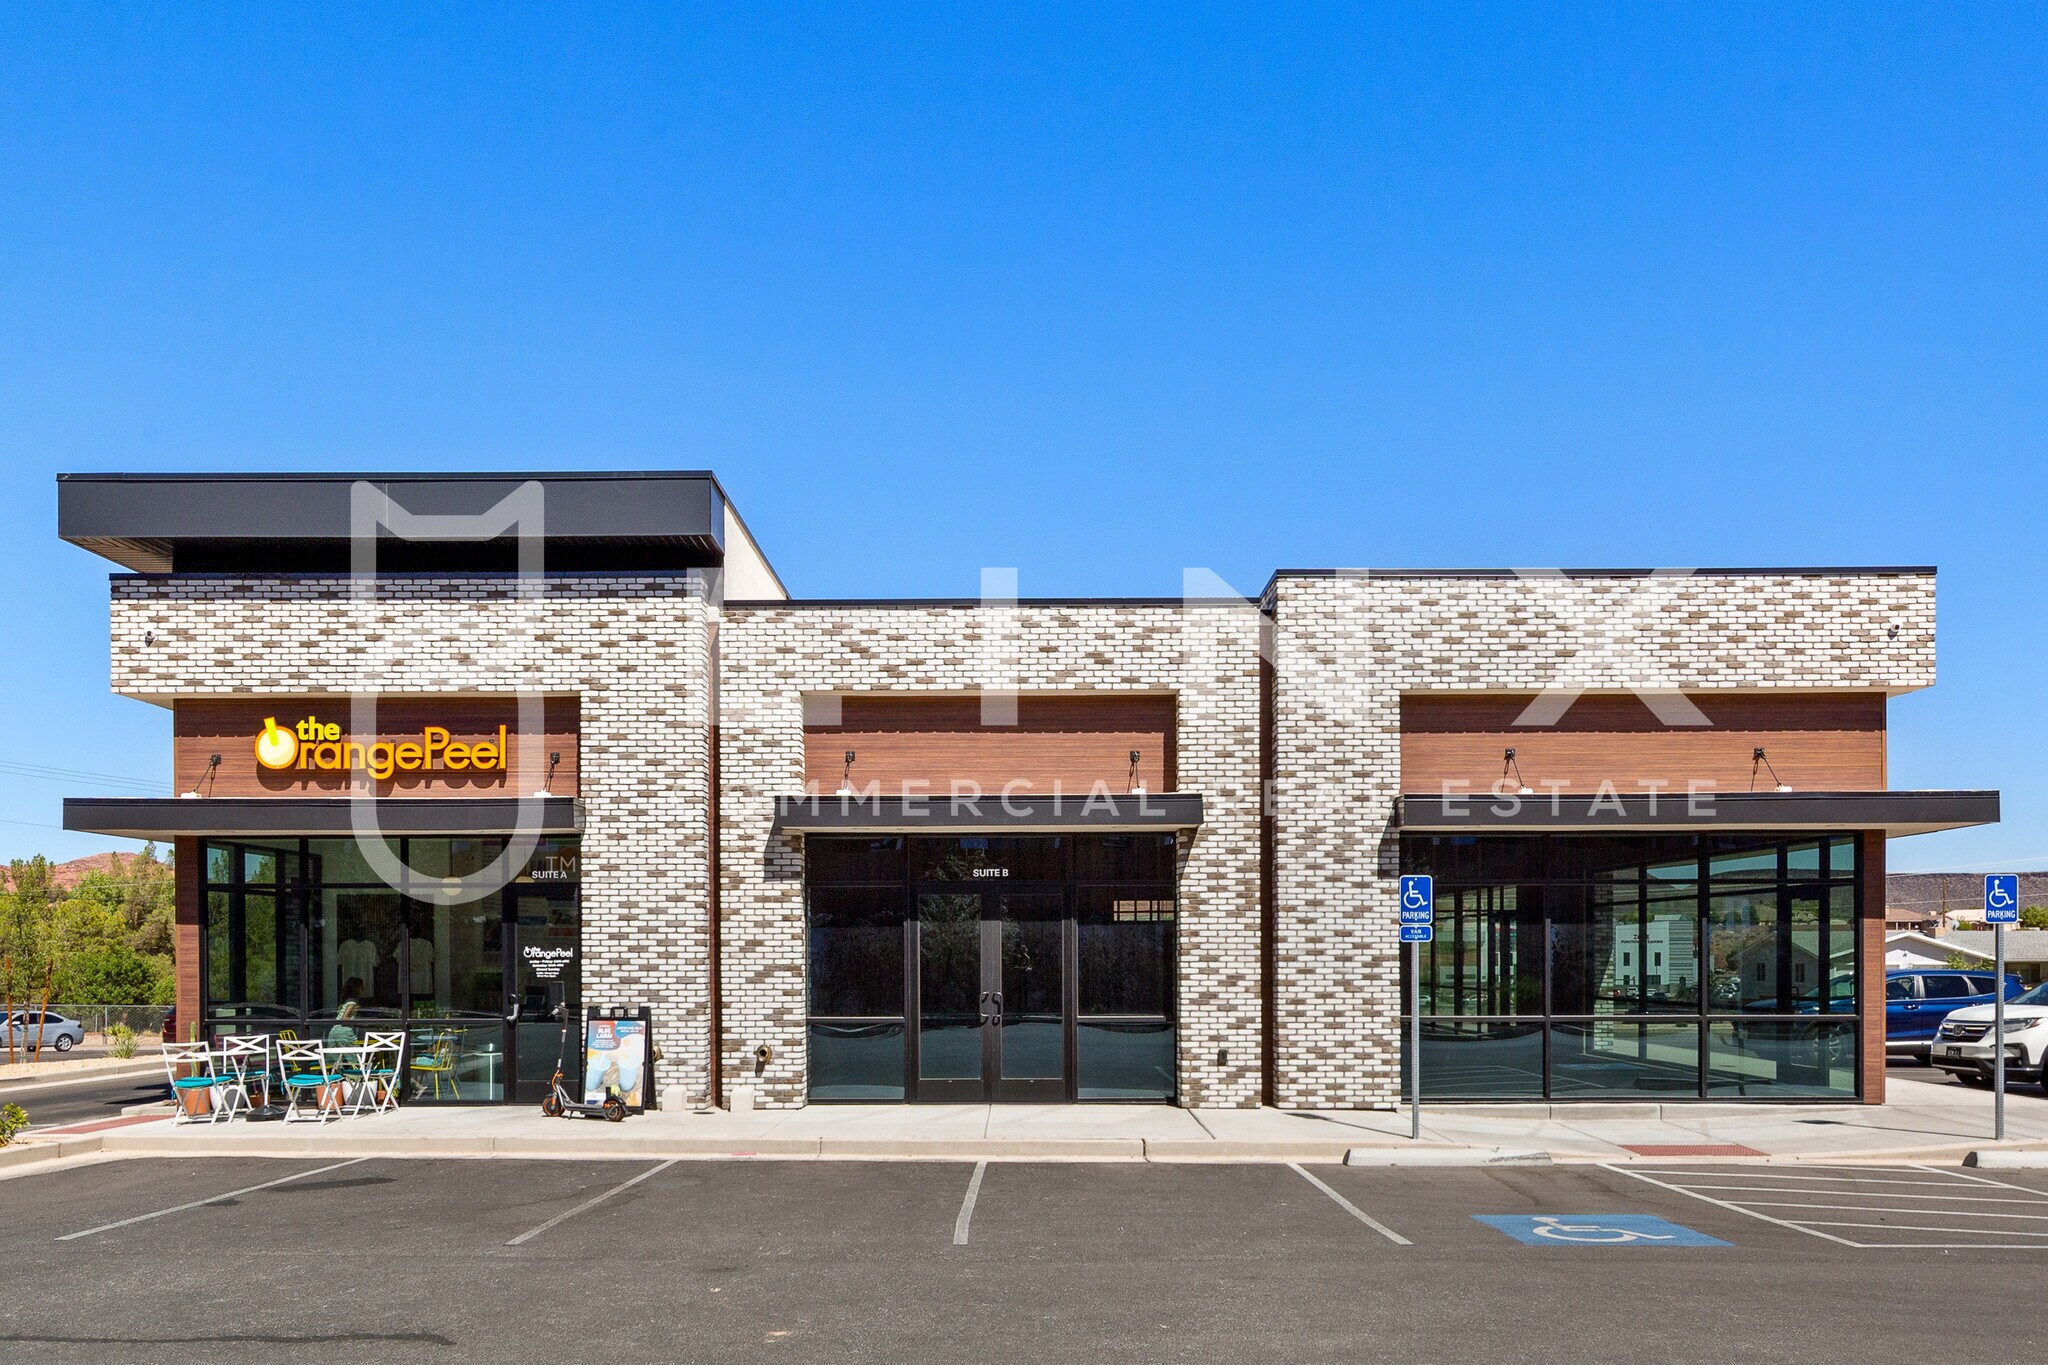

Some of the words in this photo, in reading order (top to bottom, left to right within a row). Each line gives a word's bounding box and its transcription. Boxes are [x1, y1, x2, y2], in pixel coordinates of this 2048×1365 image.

[295, 716, 341, 741] the
[531, 870, 559, 879] SUITE
[560, 870, 568, 879] A
[972, 868, 1001, 877] SUITE
[1002, 868, 1009, 877] B
[1402, 911, 1430, 920] PARKING
[1987, 909, 2016, 919] PARKING
